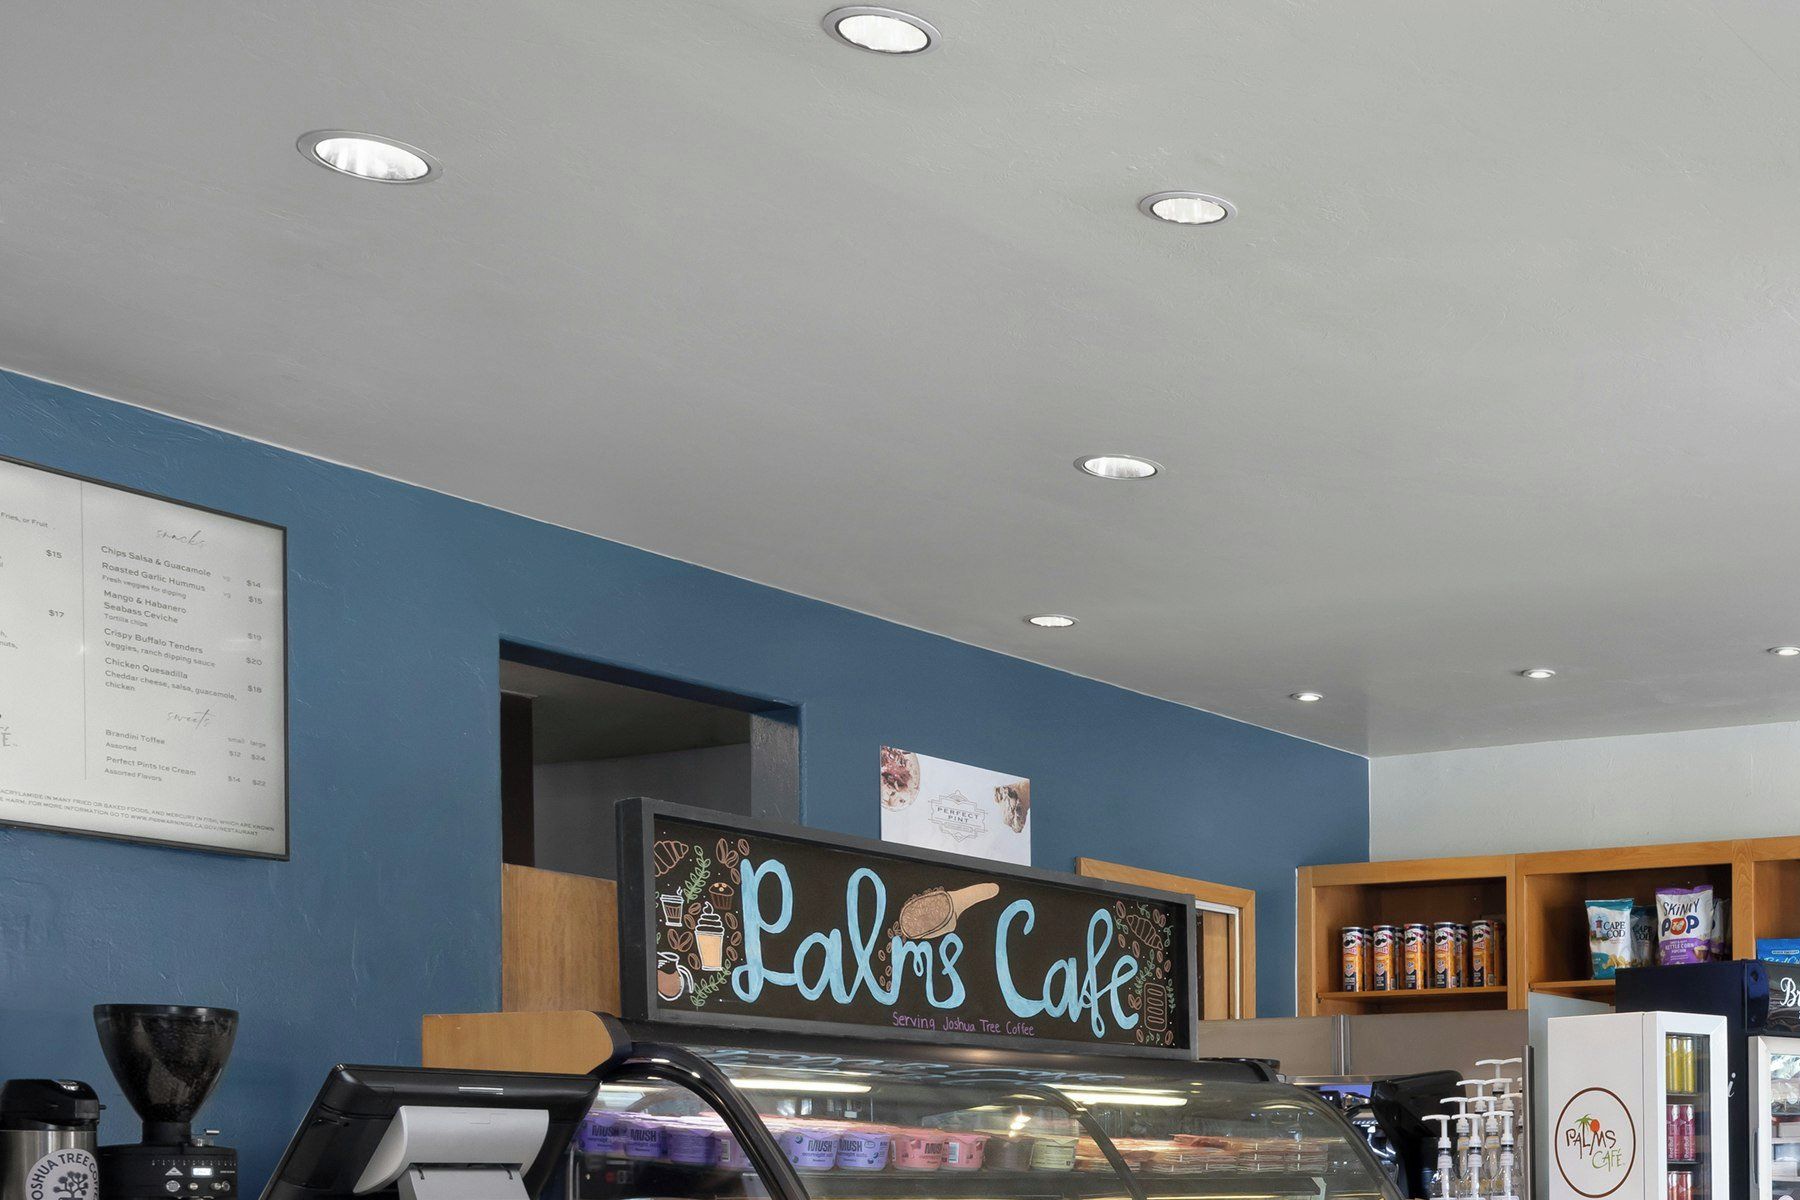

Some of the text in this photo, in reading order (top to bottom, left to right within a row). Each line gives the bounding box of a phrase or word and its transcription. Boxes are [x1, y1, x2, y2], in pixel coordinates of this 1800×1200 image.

[46, 550, 62, 559] $15
[101, 546, 126, 558] Chips
[129, 552, 152, 564] Salsa
[164, 560, 211, 577] Guacamole
[102, 562, 206, 592] Roasted Garlic Hummus
[246, 580, 261, 588] $14
[104, 590, 133, 603] Mango
[145, 599, 187, 614] Habanero
[49, 609, 64, 618] $17
[104, 602, 179, 624] Seabass Ceviche
[104, 627, 203, 654] Crispy Buffalo Tenders
[105, 641, 216, 668] Veggies, ranch dipping sauce
[246, 657, 262, 666] $20
[105, 657, 188, 679] Chicken Quesadilla
[105, 670, 138, 682] Cheddar
[140, 677, 170, 689] cheese,
[195, 687, 237, 701] guacamole,
[105, 681, 135, 692] chicken
[106, 730, 165, 745] Brandini Toffee
[106, 756, 196, 776] Perfect Pints Ice Cream
[937, 807, 978, 820] PERFECT
[948, 815, 968, 823] PINT
[732, 858, 966, 1010] Palms
[1603, 921, 1626, 930] CAPE
[1606, 929, 1626, 939] COD
[893, 1011, 1035, 1036] Serving Joshua Tree Coffee
[630, 1128, 657, 1141] MUSH
[1566, 1121, 1617, 1160] PALMS
[840, 1138, 864, 1151] MUSH
[58, 1153, 90, 1167] TREE
[1592, 1149, 1622, 1173] CAFÉ
